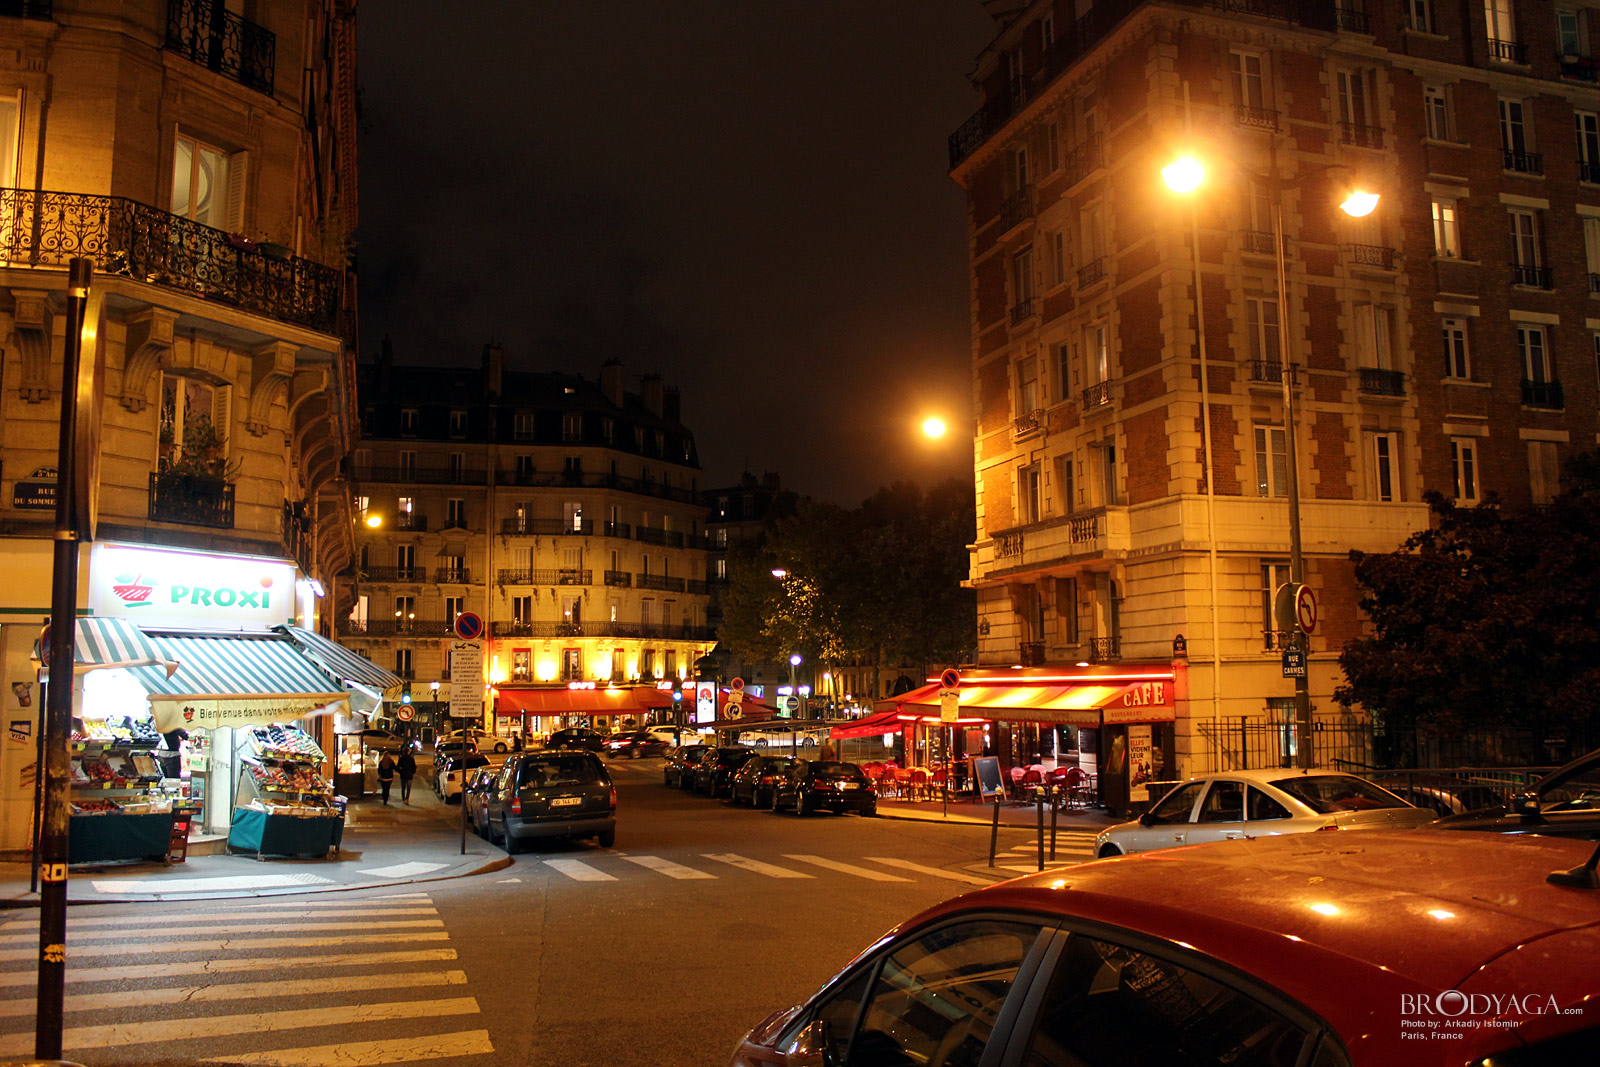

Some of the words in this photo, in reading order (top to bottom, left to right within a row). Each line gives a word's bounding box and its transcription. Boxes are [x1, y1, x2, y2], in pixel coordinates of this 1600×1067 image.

[199, 707, 243, 719] Bienvenue
[244, 707, 263, 718] dans
[263, 707, 283, 717] votre
[11, 732, 26, 741] VISA
